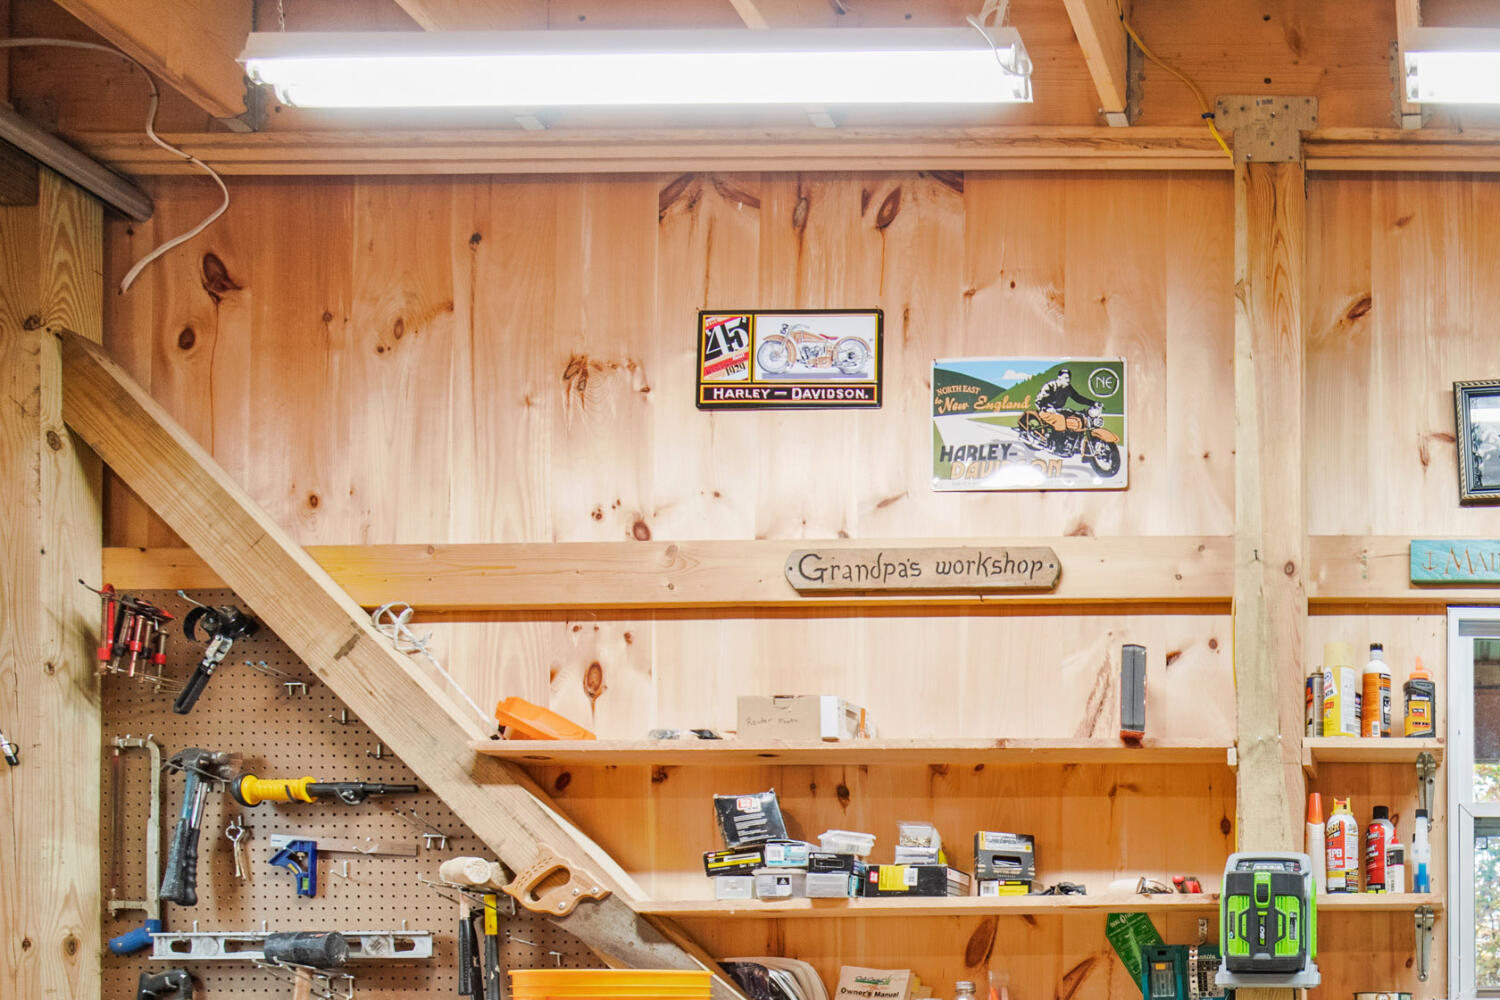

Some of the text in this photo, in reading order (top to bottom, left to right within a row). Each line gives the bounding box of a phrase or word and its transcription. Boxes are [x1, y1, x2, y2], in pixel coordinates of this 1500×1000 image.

[713, 387, 769, 400] HARLEY
[938, 397, 969, 415] New
[973, 394, 1031, 412] England
[797, 551, 1044, 584] Grandpa's workshop
[873, 991, 900, 999] Manual
